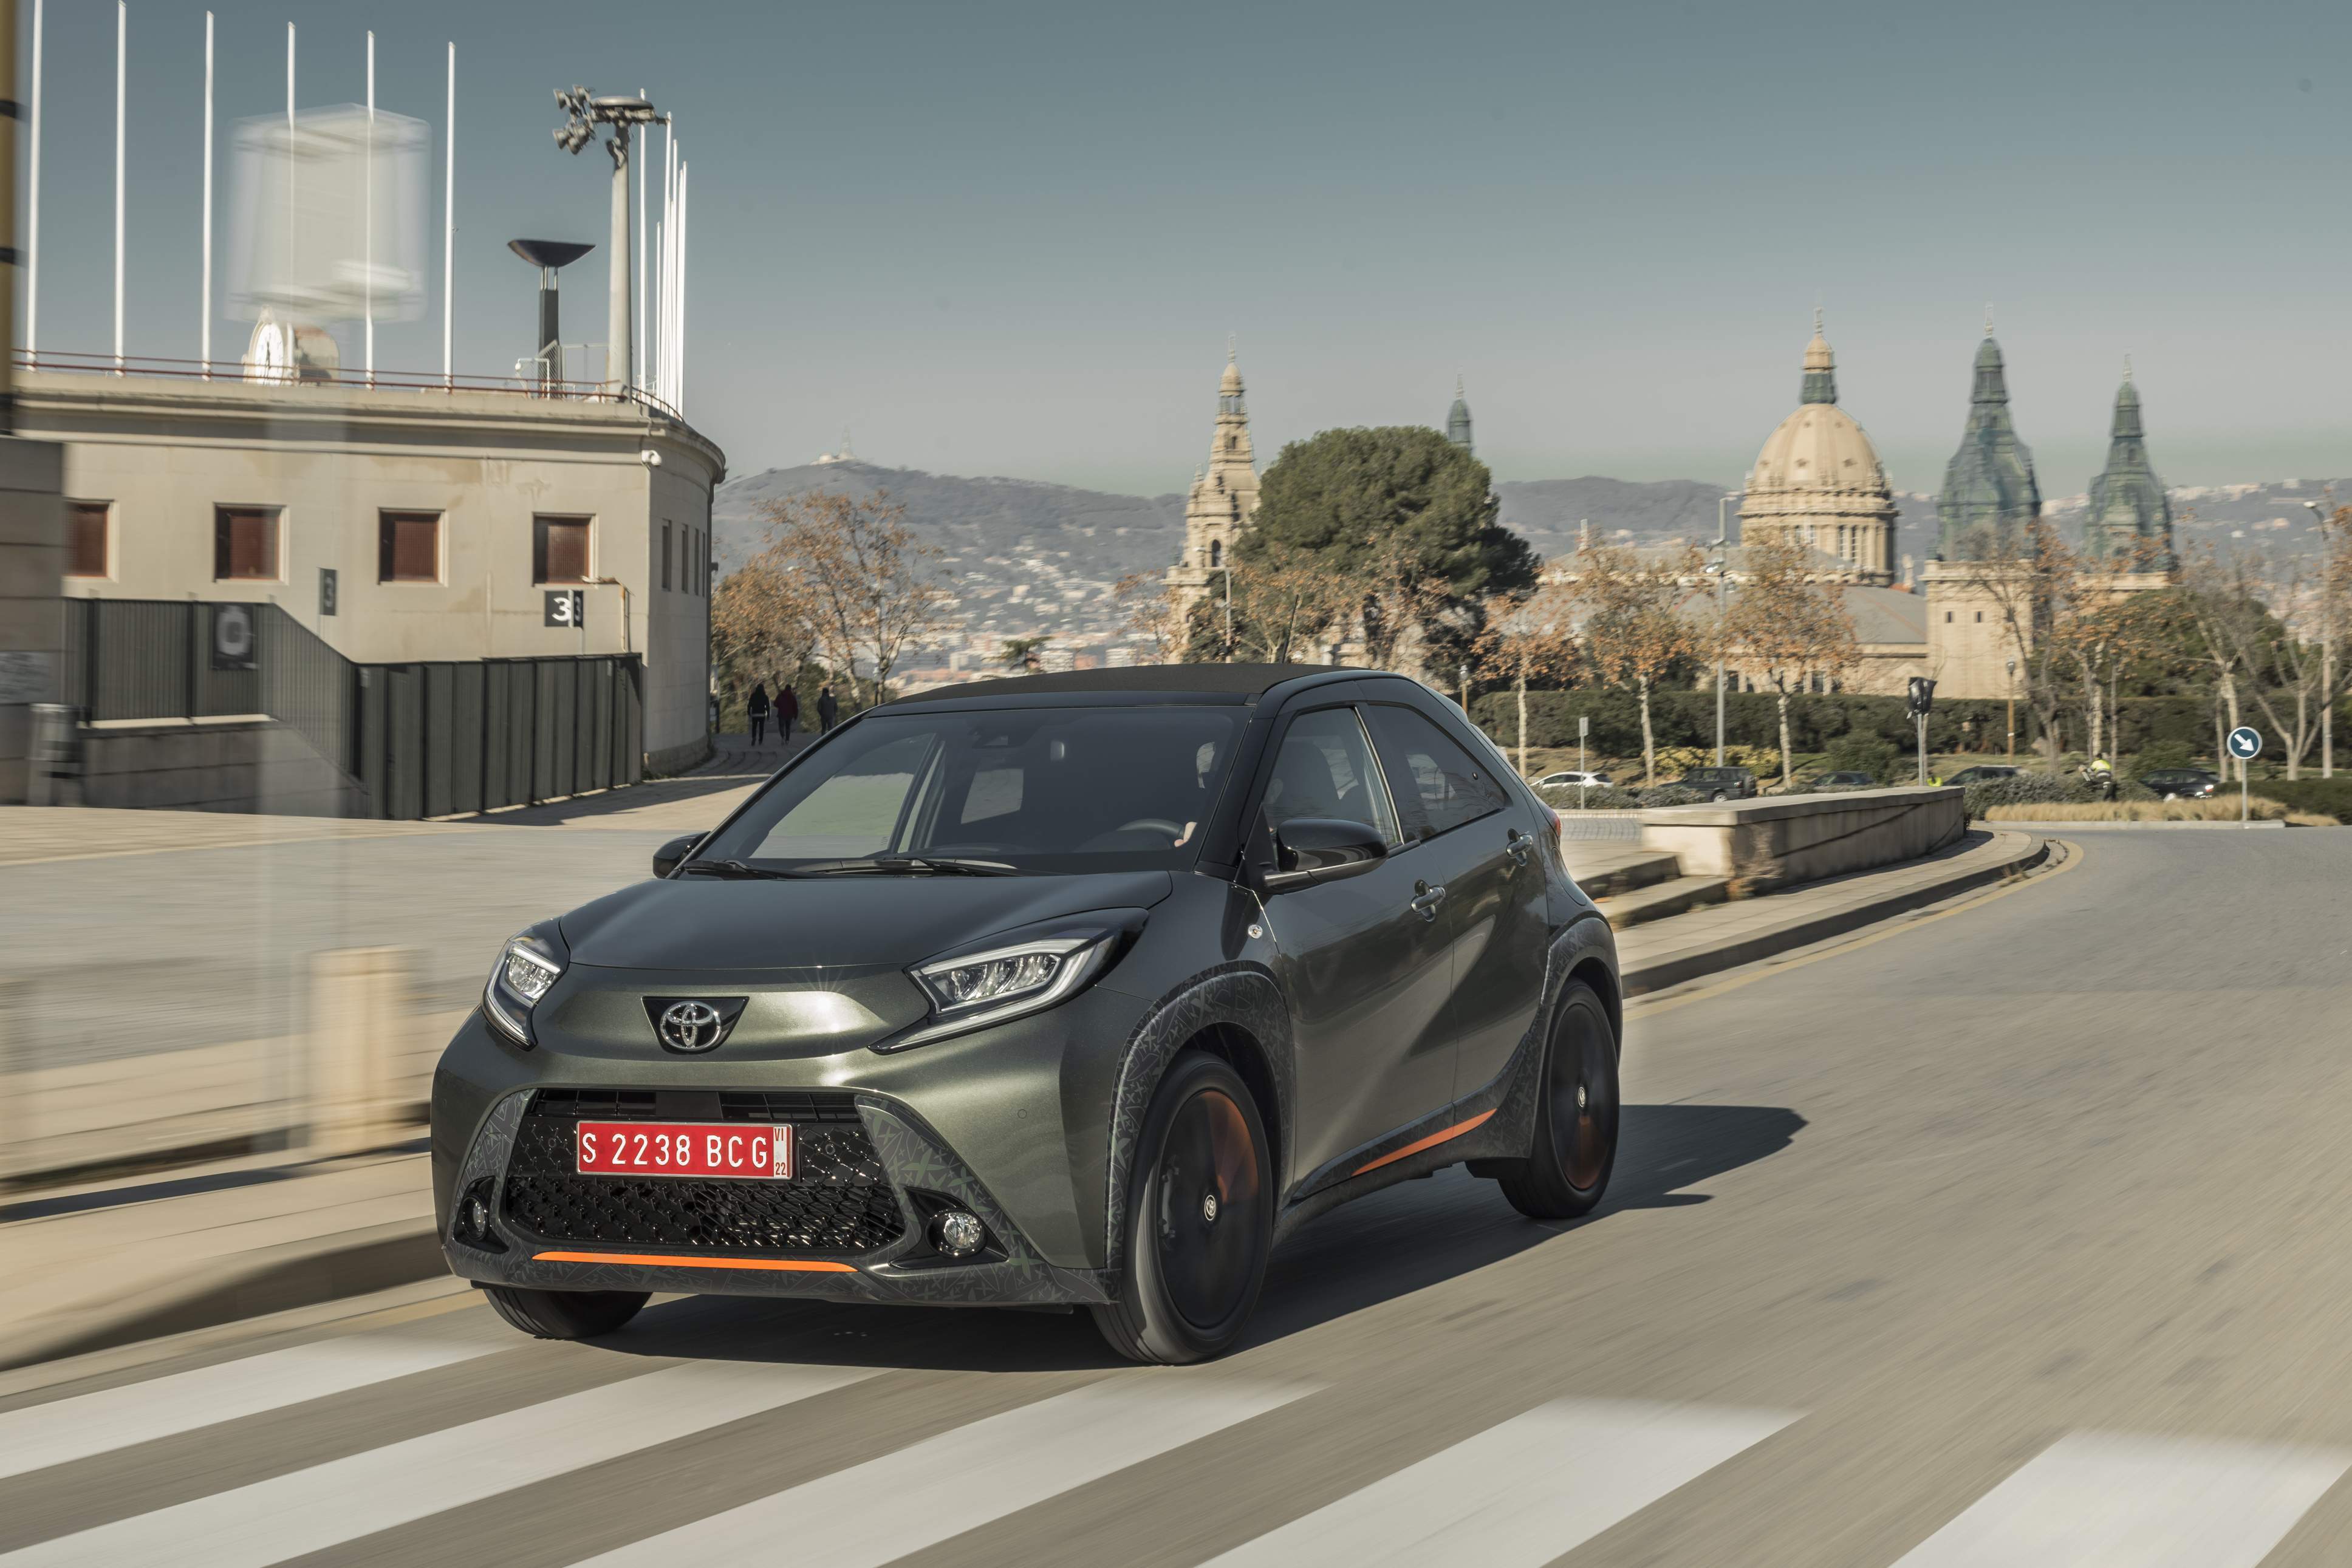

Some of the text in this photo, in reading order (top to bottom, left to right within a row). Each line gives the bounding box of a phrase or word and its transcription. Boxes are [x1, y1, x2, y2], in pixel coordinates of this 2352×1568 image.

[552, 596, 572, 621] 3
[774, 1128, 784, 1141] VI
[582, 1133, 768, 1168] S 2238 BCG
[775, 1162, 787, 1176] 22
